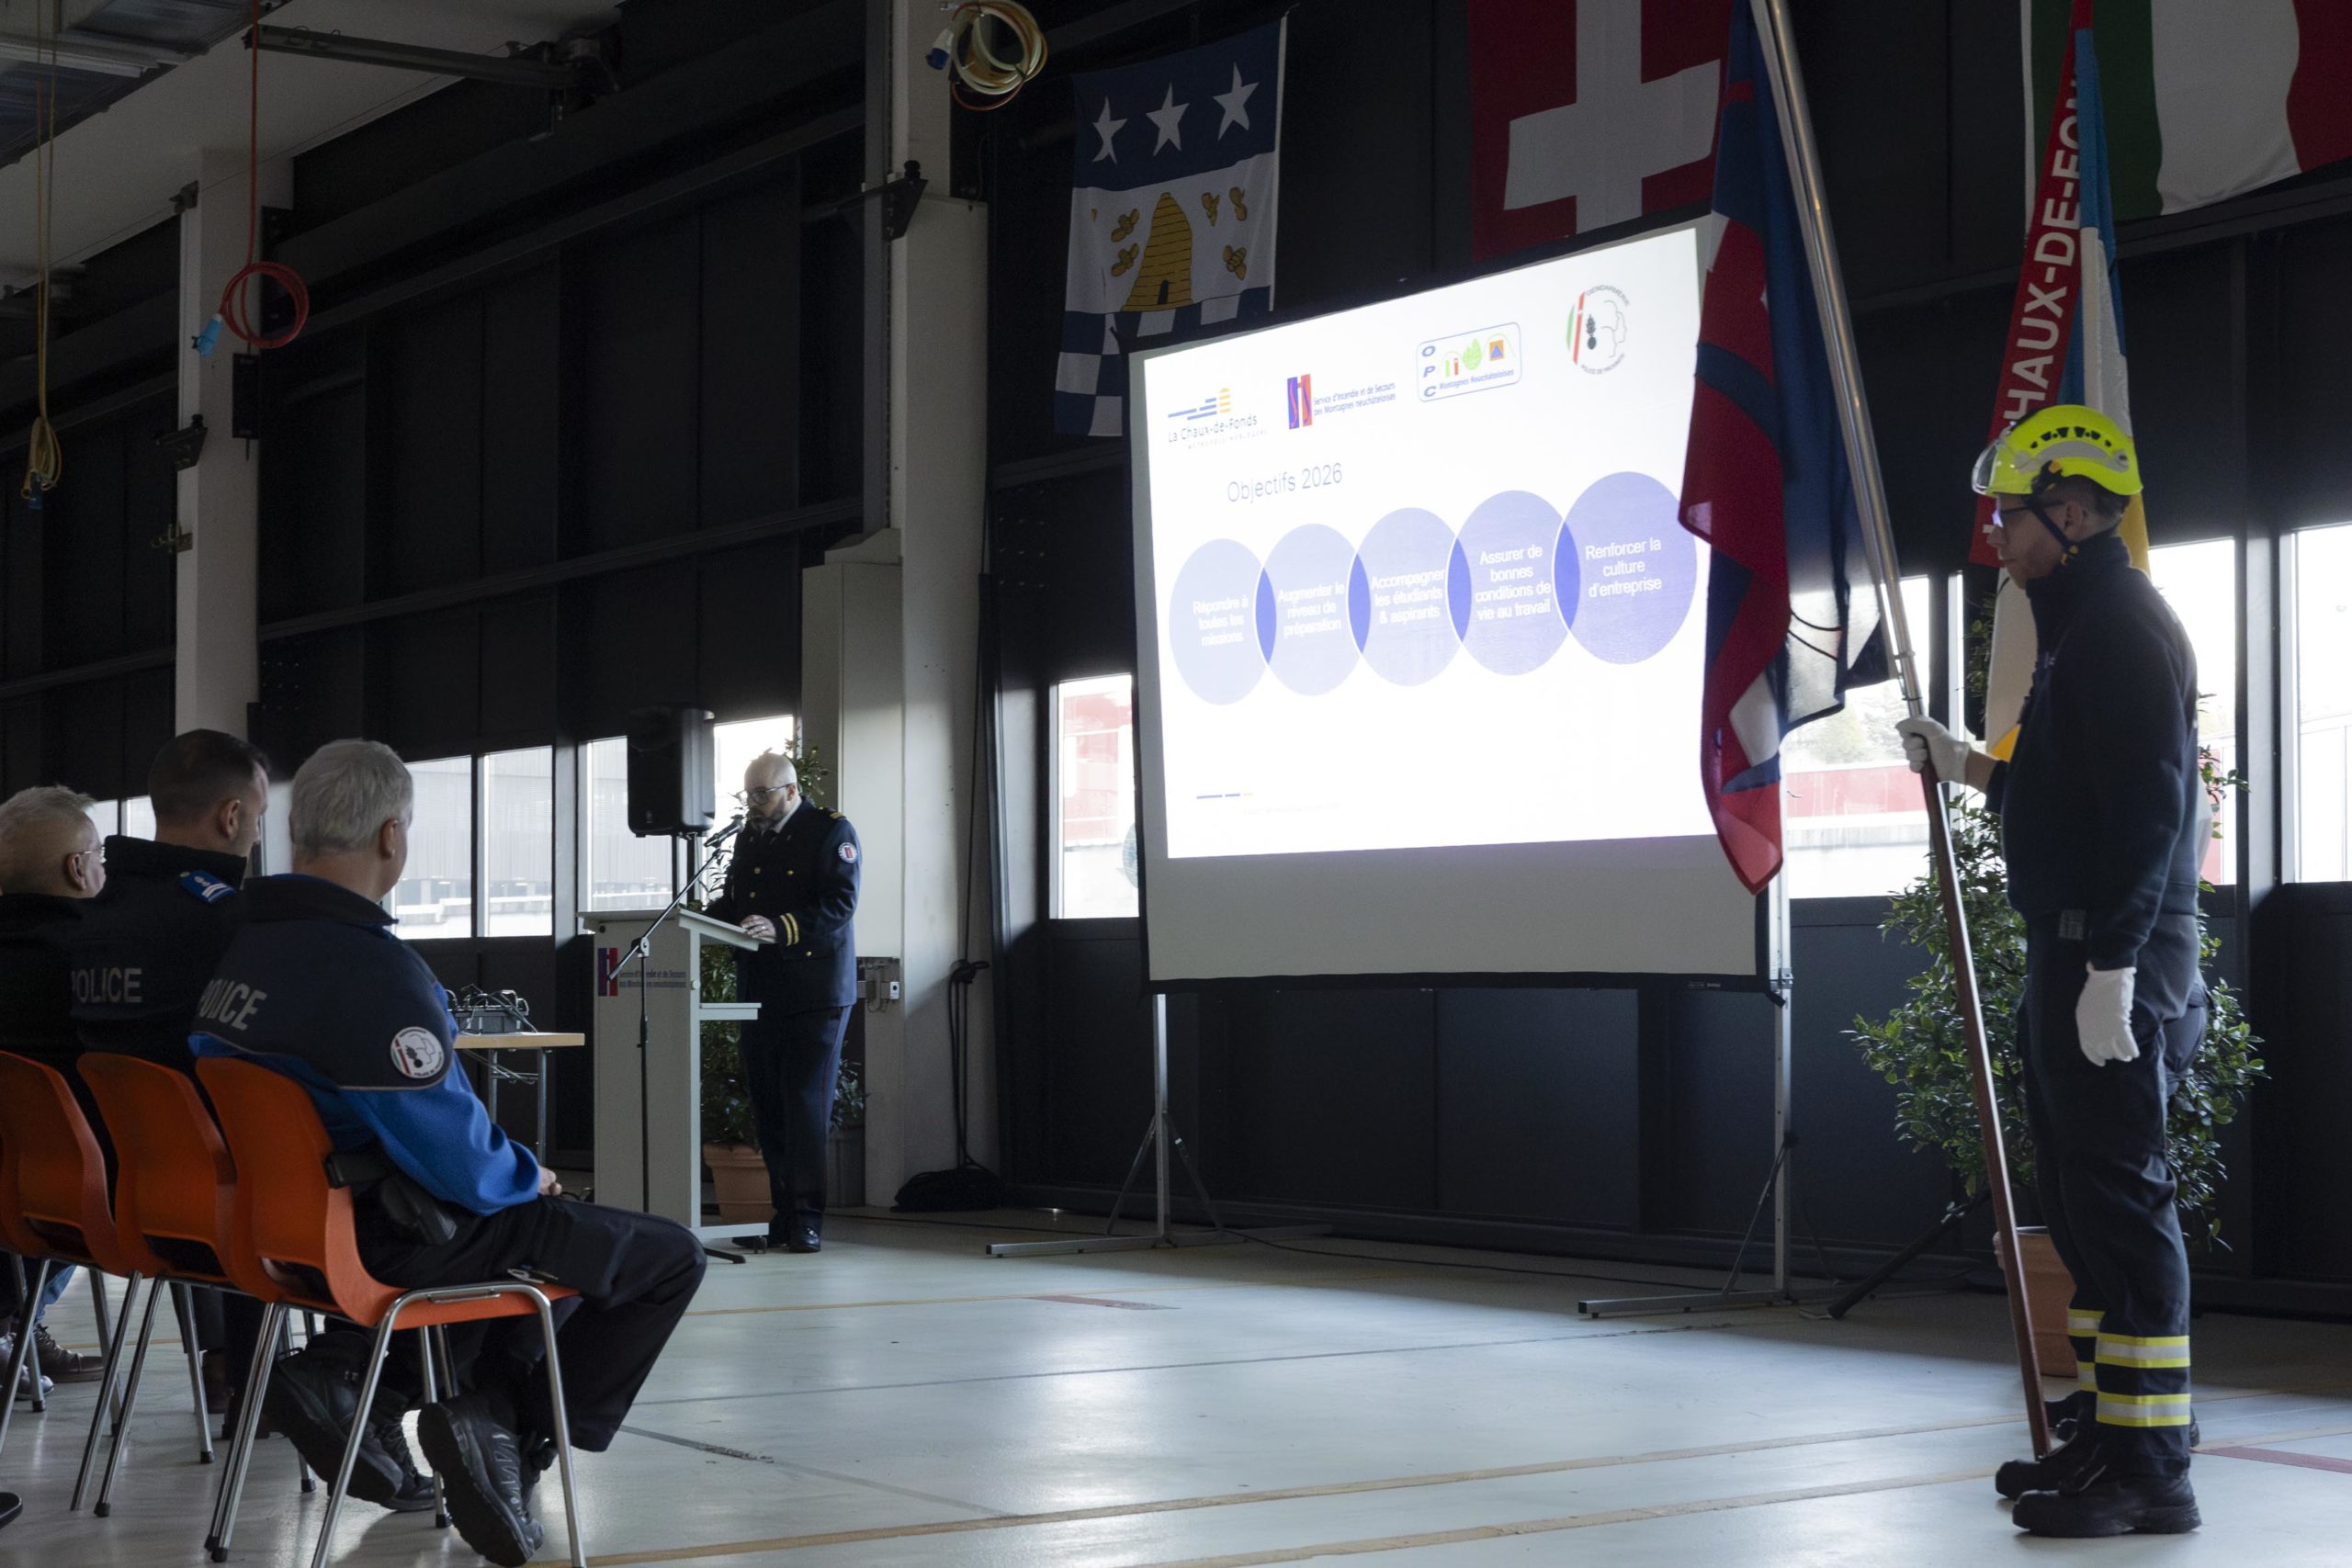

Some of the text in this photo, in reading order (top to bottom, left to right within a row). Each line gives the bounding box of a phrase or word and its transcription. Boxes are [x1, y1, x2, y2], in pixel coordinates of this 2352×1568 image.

[1168, 431, 1178, 443] La
[1181, 414, 1258, 440] Chaux-de-Fonds
[1227, 462, 1342, 503] Objectifs 2026
[1479, 544, 1543, 565] Assurer de
[1586, 536, 1661, 560] Renforcer la
[1490, 566, 1533, 582] bonnes
[1602, 560, 1645, 577] culture
[1370, 569, 1446, 590] Accompagner
[1589, 577, 1662, 598] d'entreprise
[1278, 581, 1345, 604] Augmenter le
[1374, 587, 1442, 607] les étudiants
[1475, 581, 1552, 603] conditions de
[1287, 601, 1337, 620] niveau de
[1379, 604, 1441, 625] & aspirants
[1476, 599, 1551, 621] vie au travail
